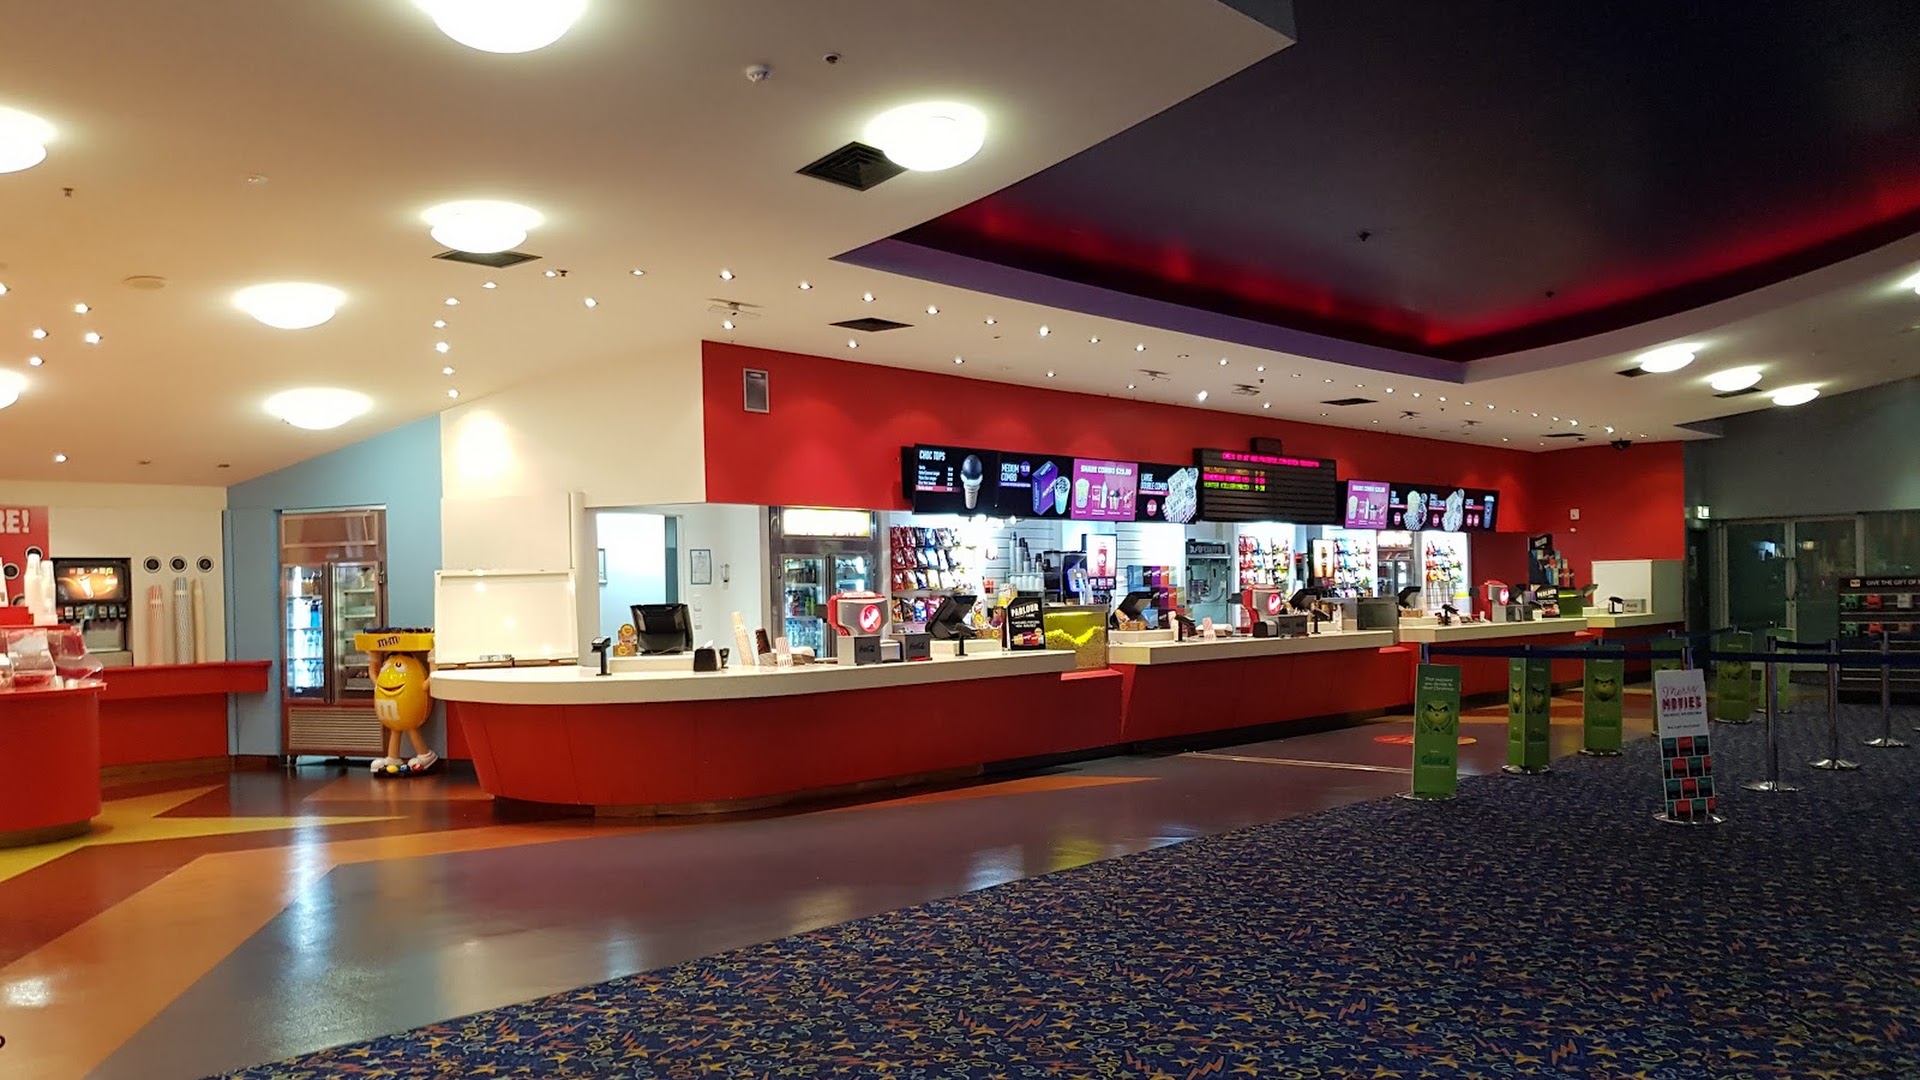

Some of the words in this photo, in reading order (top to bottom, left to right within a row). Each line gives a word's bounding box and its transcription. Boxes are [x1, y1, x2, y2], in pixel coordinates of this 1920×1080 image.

[933, 450, 946, 461] TOPS
[1001, 463, 1020, 473] MEDIUM
[1000, 472, 1017, 482] COMBO
[1011, 603, 1039, 617] PARLOUR
[1662, 696, 1701, 710] MOVIES
